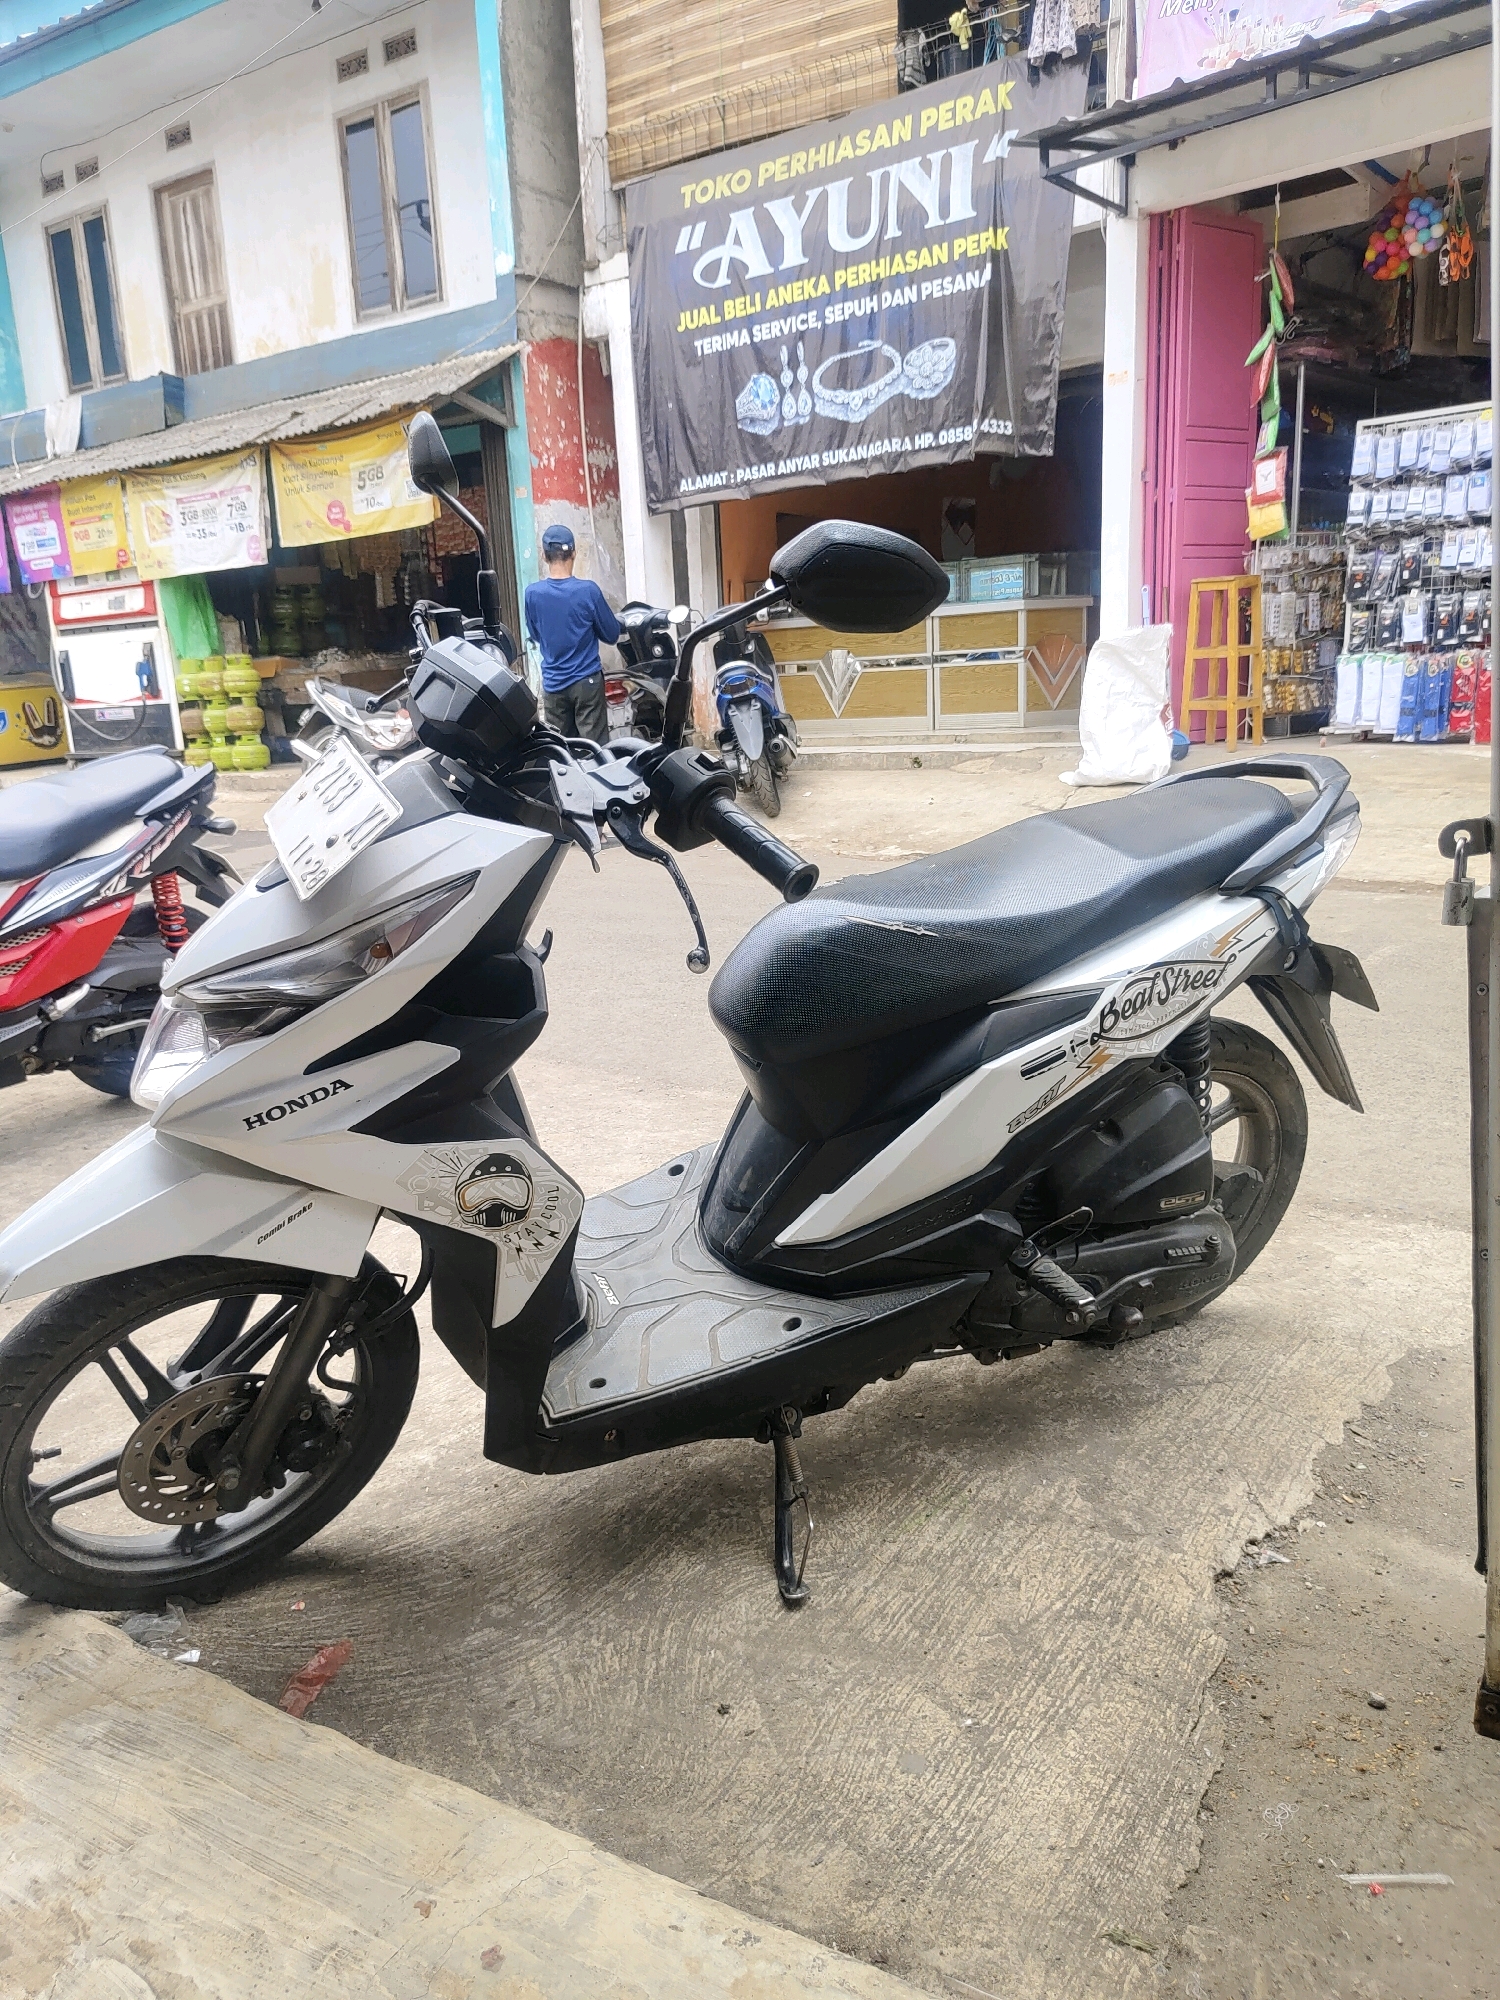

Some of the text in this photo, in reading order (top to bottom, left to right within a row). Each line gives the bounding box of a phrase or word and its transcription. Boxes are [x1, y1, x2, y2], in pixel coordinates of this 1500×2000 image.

[681, 81, 1017, 209] TOKO PERHIASAN PERAK
[676, 304, 721, 333] JUAL
[723, 292, 761, 321] BELI
[765, 274, 831, 310] ANEKA
[834, 241, 949, 292] PERHIASAN
[694, 329, 750, 357] TERIMA
[752, 310, 822, 343] SERVICE,
[824, 294, 879, 325] SEPUH
[881, 284, 918, 310] DAN
[680, 472, 728, 492] ALAMAT
[737, 462, 776, 483] PASAR
[777, 453, 820, 475] ANYAR
[822, 435, 913, 467] SUKANAGARA
[914, 431, 936, 450] HP.
[242, 1078, 354, 1131] HONDA
[256, 1200, 314, 1245] Combi Brake
[503, 1185, 561, 1245] STAY COOL
